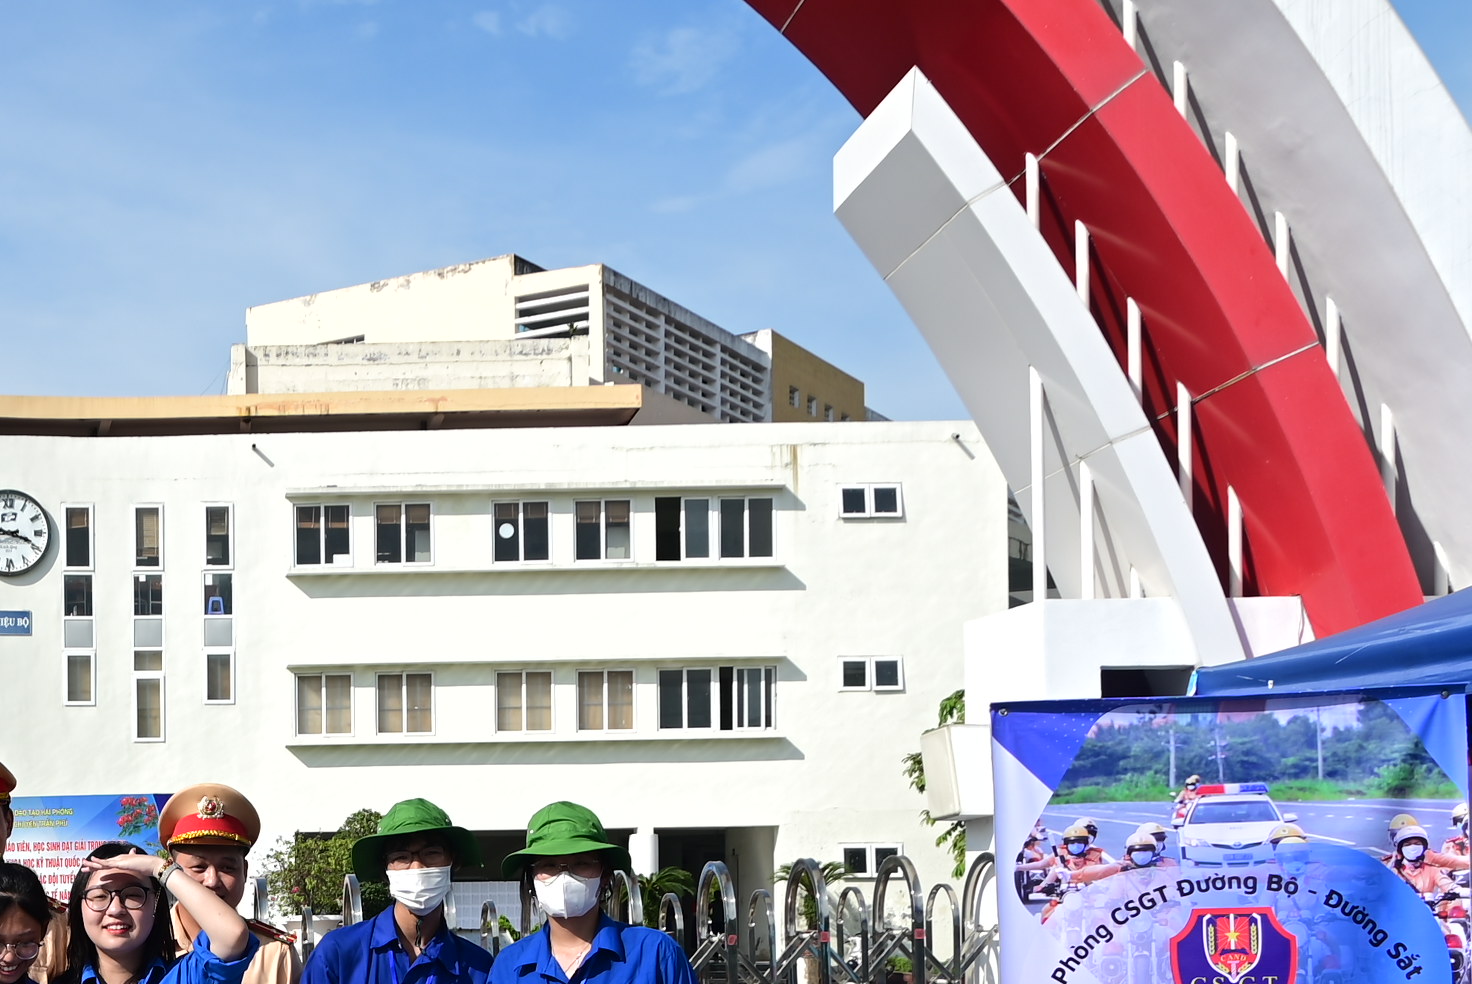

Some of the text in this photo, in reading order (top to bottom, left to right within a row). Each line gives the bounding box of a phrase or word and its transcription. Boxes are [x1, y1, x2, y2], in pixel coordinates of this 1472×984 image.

[17, 616, 30, 628] BỘ
[33, 842, 45, 854] HỌC
[46, 842, 60, 852] SINH
[62, 841, 72, 853] ĐẠT
[46, 856, 64, 870] THUẬT
[65, 856, 80, 868] QUỐC
[1051, 924, 1114, 984] Phòng
[1110, 885, 1169, 926] CSGT
[1176, 872, 1258, 898] Đường
[1266, 873, 1300, 898] Bộ
[1323, 888, 1390, 948] Đường
[1386, 940, 1425, 982] Sắt
